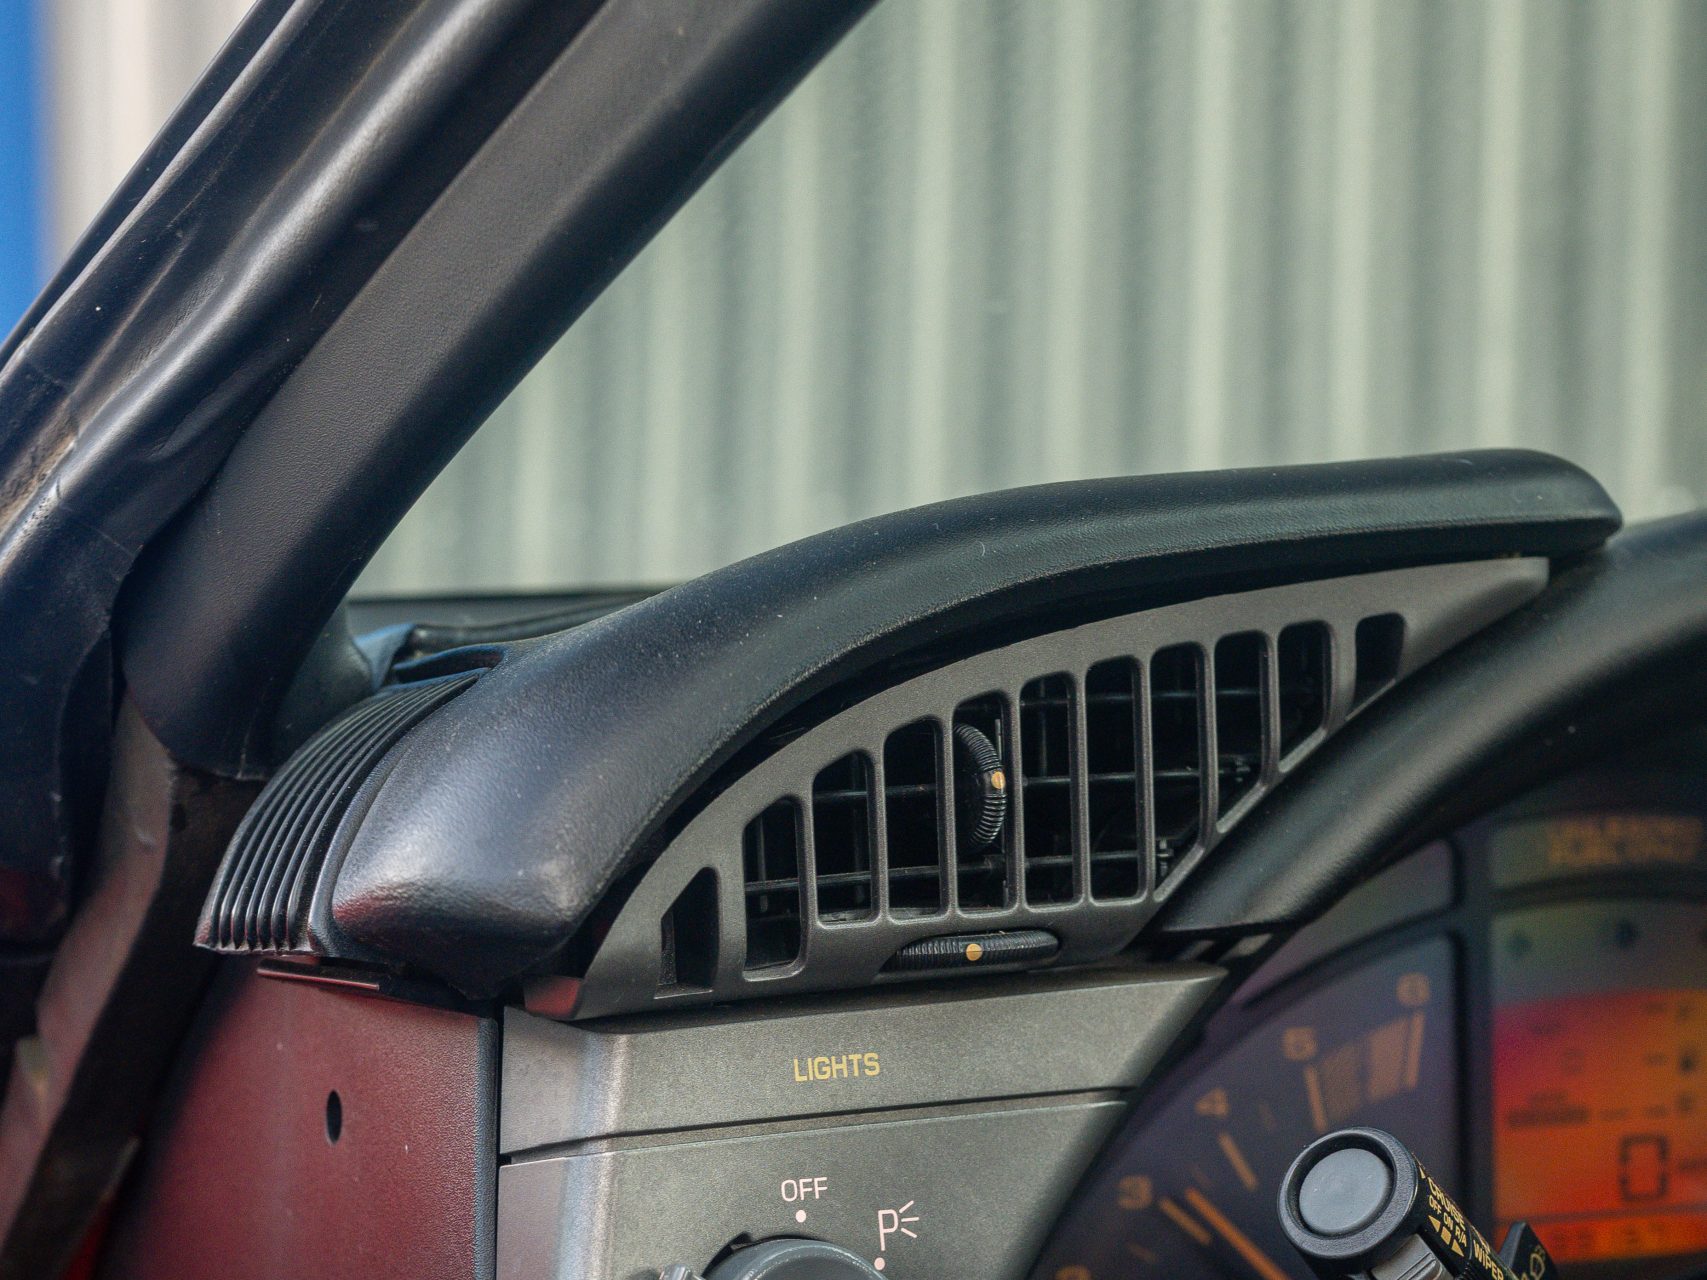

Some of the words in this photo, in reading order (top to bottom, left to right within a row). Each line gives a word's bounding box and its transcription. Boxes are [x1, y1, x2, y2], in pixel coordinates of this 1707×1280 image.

[794, 1053, 880, 1082] LIGHTS
[781, 1177, 828, 1202] OFF
[1426, 1176, 1466, 1232] CRUISE
[878, 1208, 899, 1251] P
[1428, 1194, 1442, 1215] OFF
[1443, 1211, 1454, 1231] ON
